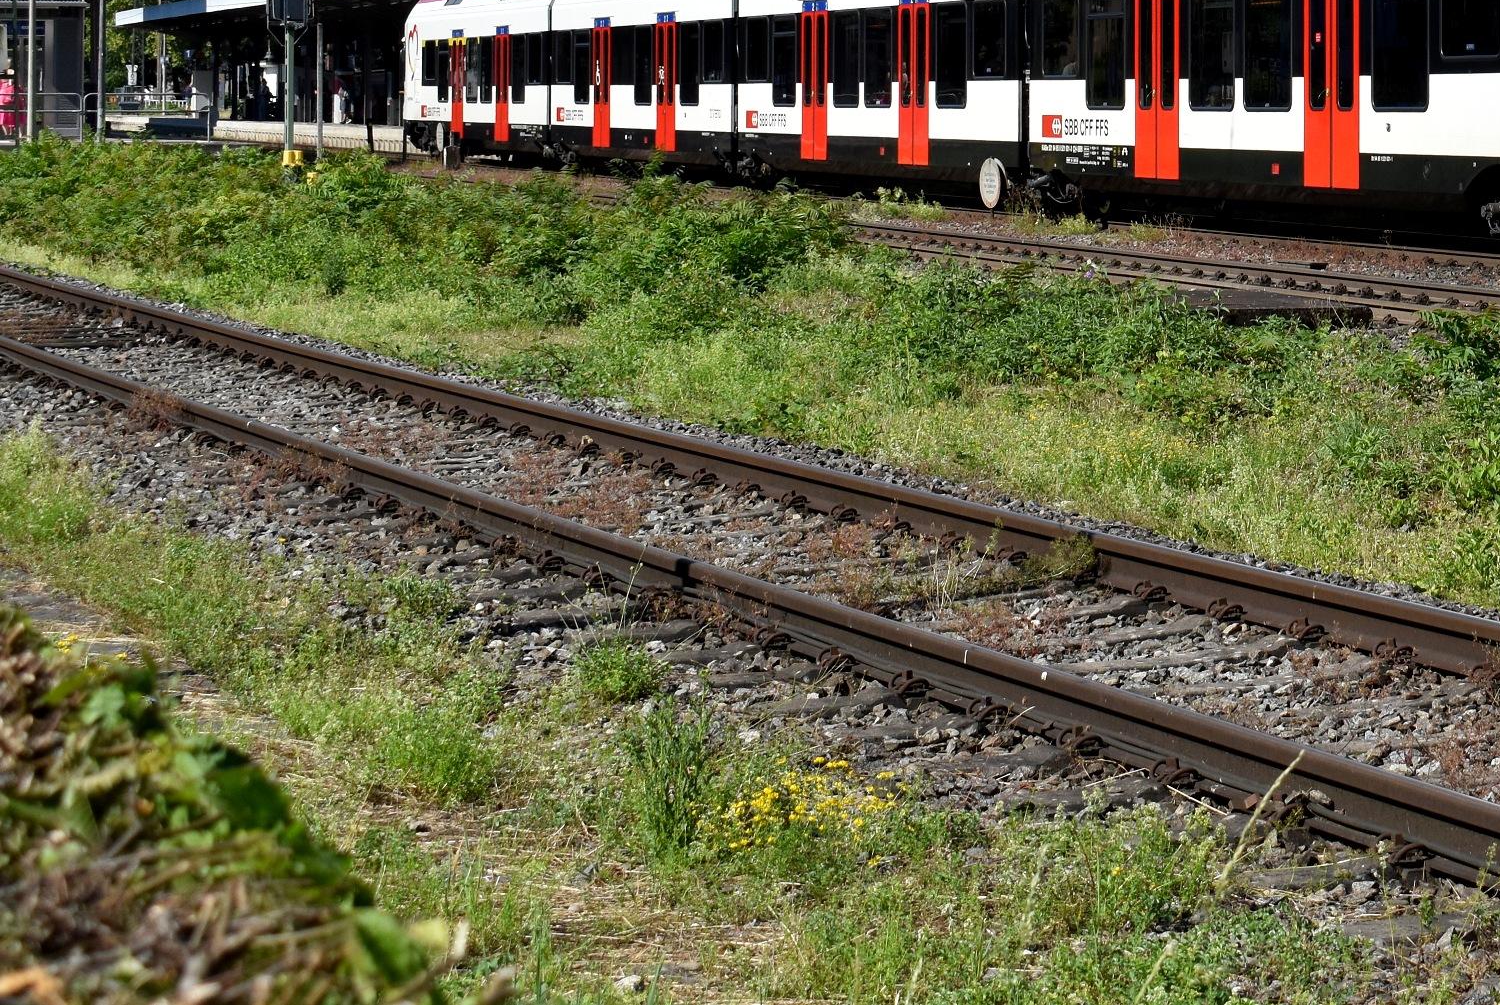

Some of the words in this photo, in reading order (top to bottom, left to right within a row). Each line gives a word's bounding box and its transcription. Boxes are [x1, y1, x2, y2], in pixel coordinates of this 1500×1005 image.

[1064, 118, 1079, 136] SBB
[1080, 118, 1094, 136] CFF
[1095, 119, 1109, 137] FFS
